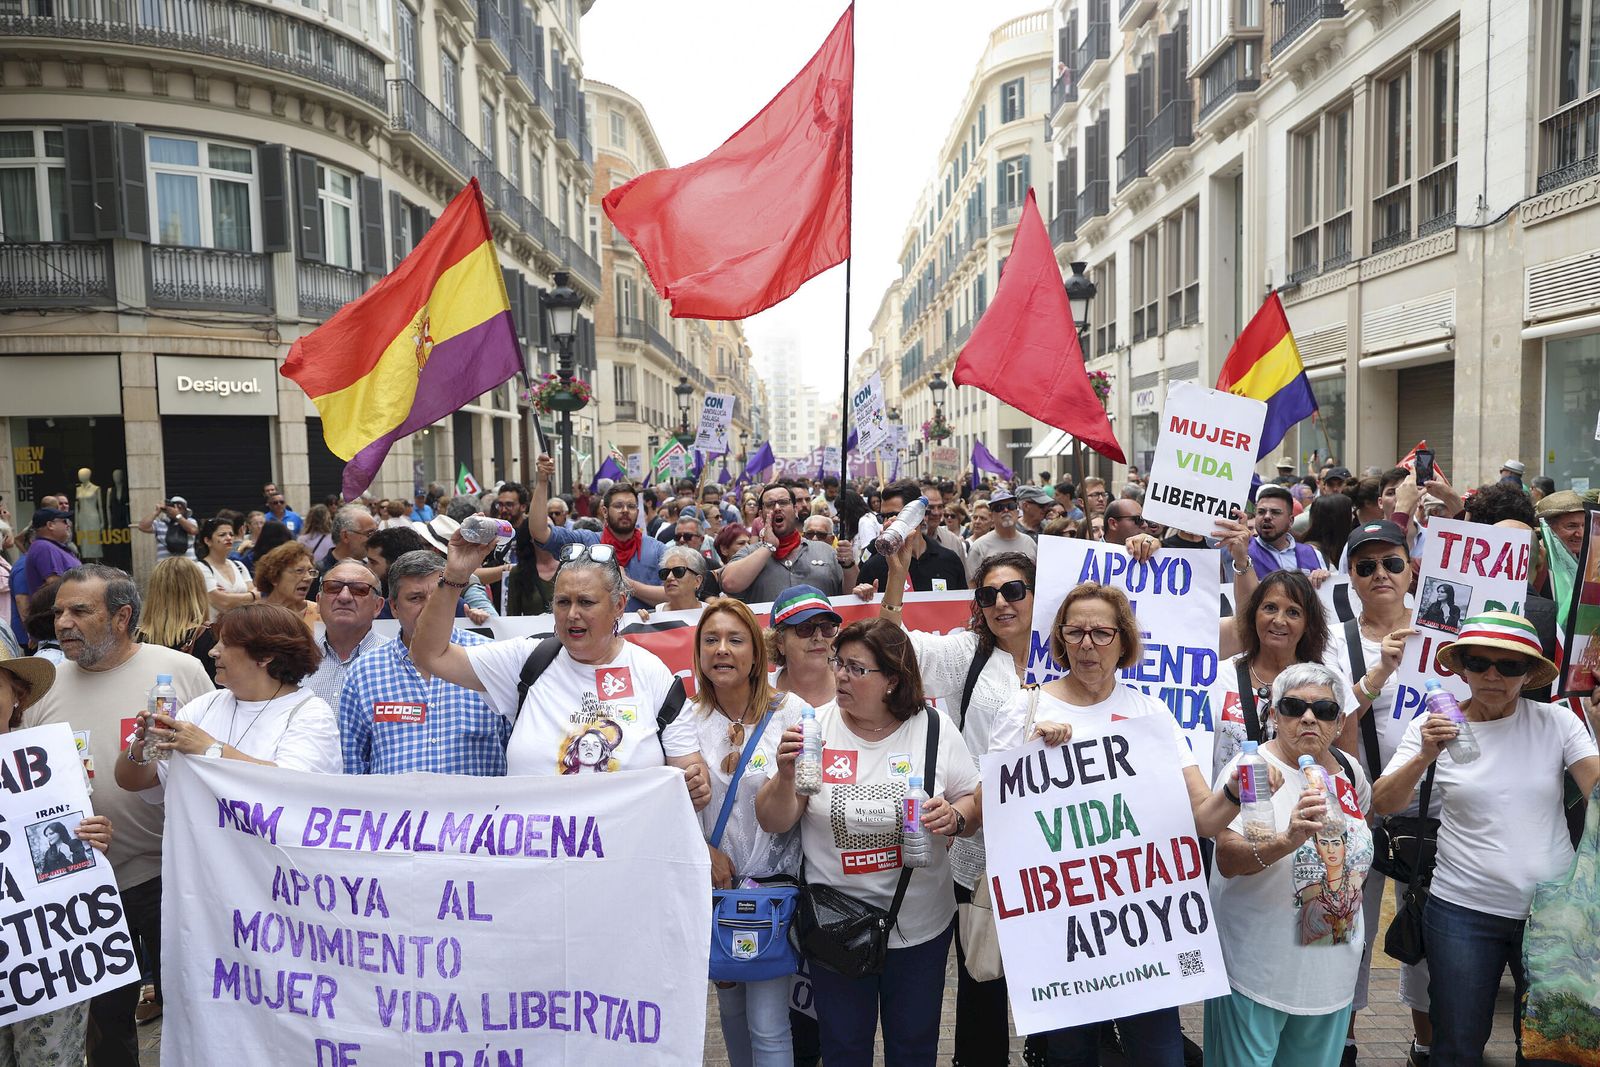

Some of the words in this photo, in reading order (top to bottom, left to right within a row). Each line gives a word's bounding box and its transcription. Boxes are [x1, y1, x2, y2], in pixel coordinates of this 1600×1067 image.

[177, 375, 262, 396] Desigual.
[705, 397, 723, 409] CON
[854, 384, 871, 407] CON
[1137, 390, 1154, 407] KIKO
[1169, 416, 1251, 451] MUJER
[14, 446, 44, 461] NEW
[16, 460, 44, 475] IDOL
[1176, 449, 1233, 481] VIDA
[1151, 482, 1241, 521] LIBERTAD
[1077, 548, 1192, 596] APOYO
[376, 705, 412, 715] CCOO
[1000, 734, 1136, 804] MUJER
[855, 807, 866, 816] My
[868, 807, 886, 816] soul
[1034, 793, 1141, 852] VIDA
[301, 805, 605, 859] BENALMÁDENA
[844, 851, 888, 867] CCOO
[272, 865, 390, 919] APOYA
[437, 880, 493, 922] AL
[992, 836, 1202, 920] LIBERTAD
[233, 909, 462, 979] MOVIMIENTO
[1067, 891, 1209, 963] APOYO
[1032, 962, 1171, 1002] INTERNACIONAL
[212, 958, 338, 1019] MUJER
[375, 985, 468, 1034] VIDA
[481, 990, 662, 1043] LIBERTAD
[315, 1038, 361, 1067] DE
